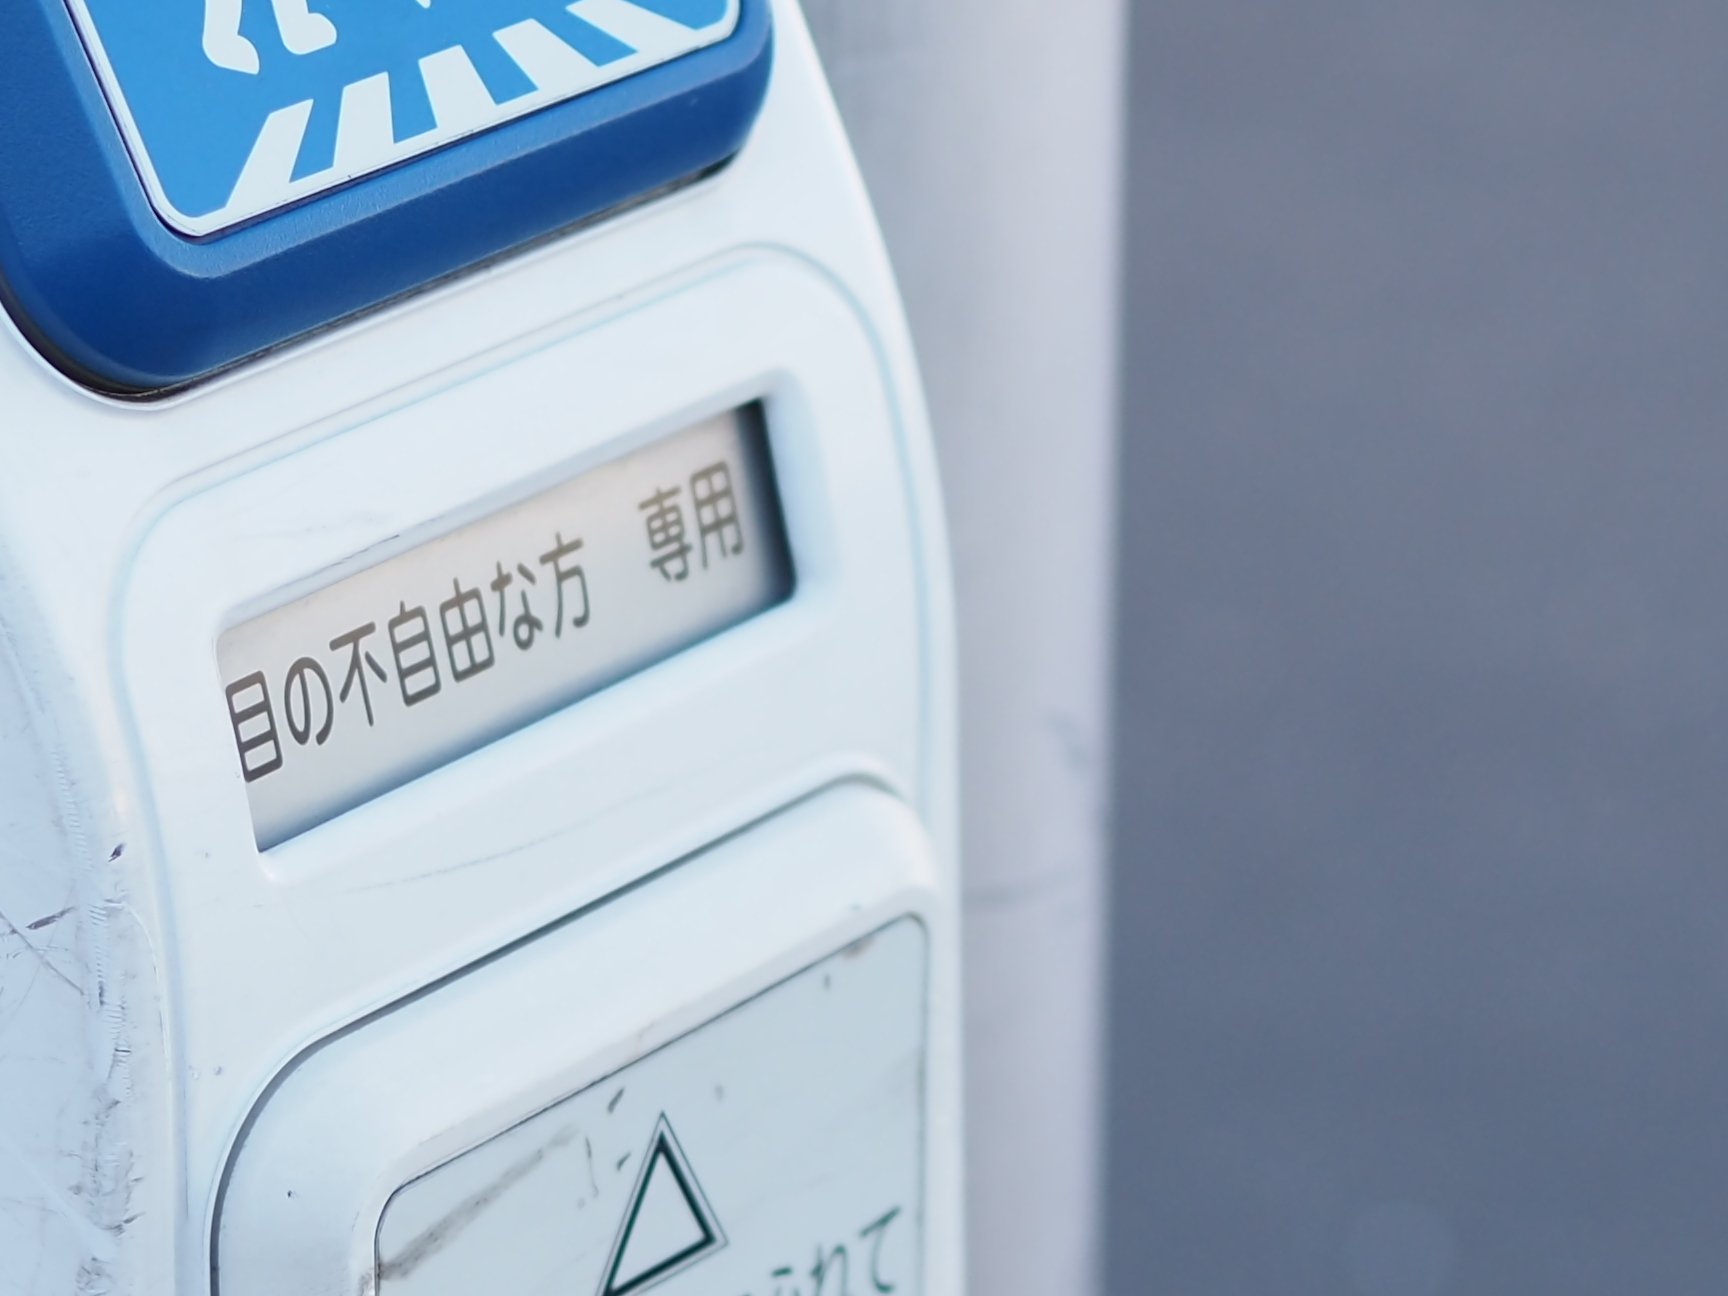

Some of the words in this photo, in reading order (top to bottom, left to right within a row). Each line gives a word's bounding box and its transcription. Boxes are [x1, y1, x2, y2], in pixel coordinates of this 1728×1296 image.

[225, 531, 592, 785] 目の不自由な方
[636, 460, 746, 585] 専用
